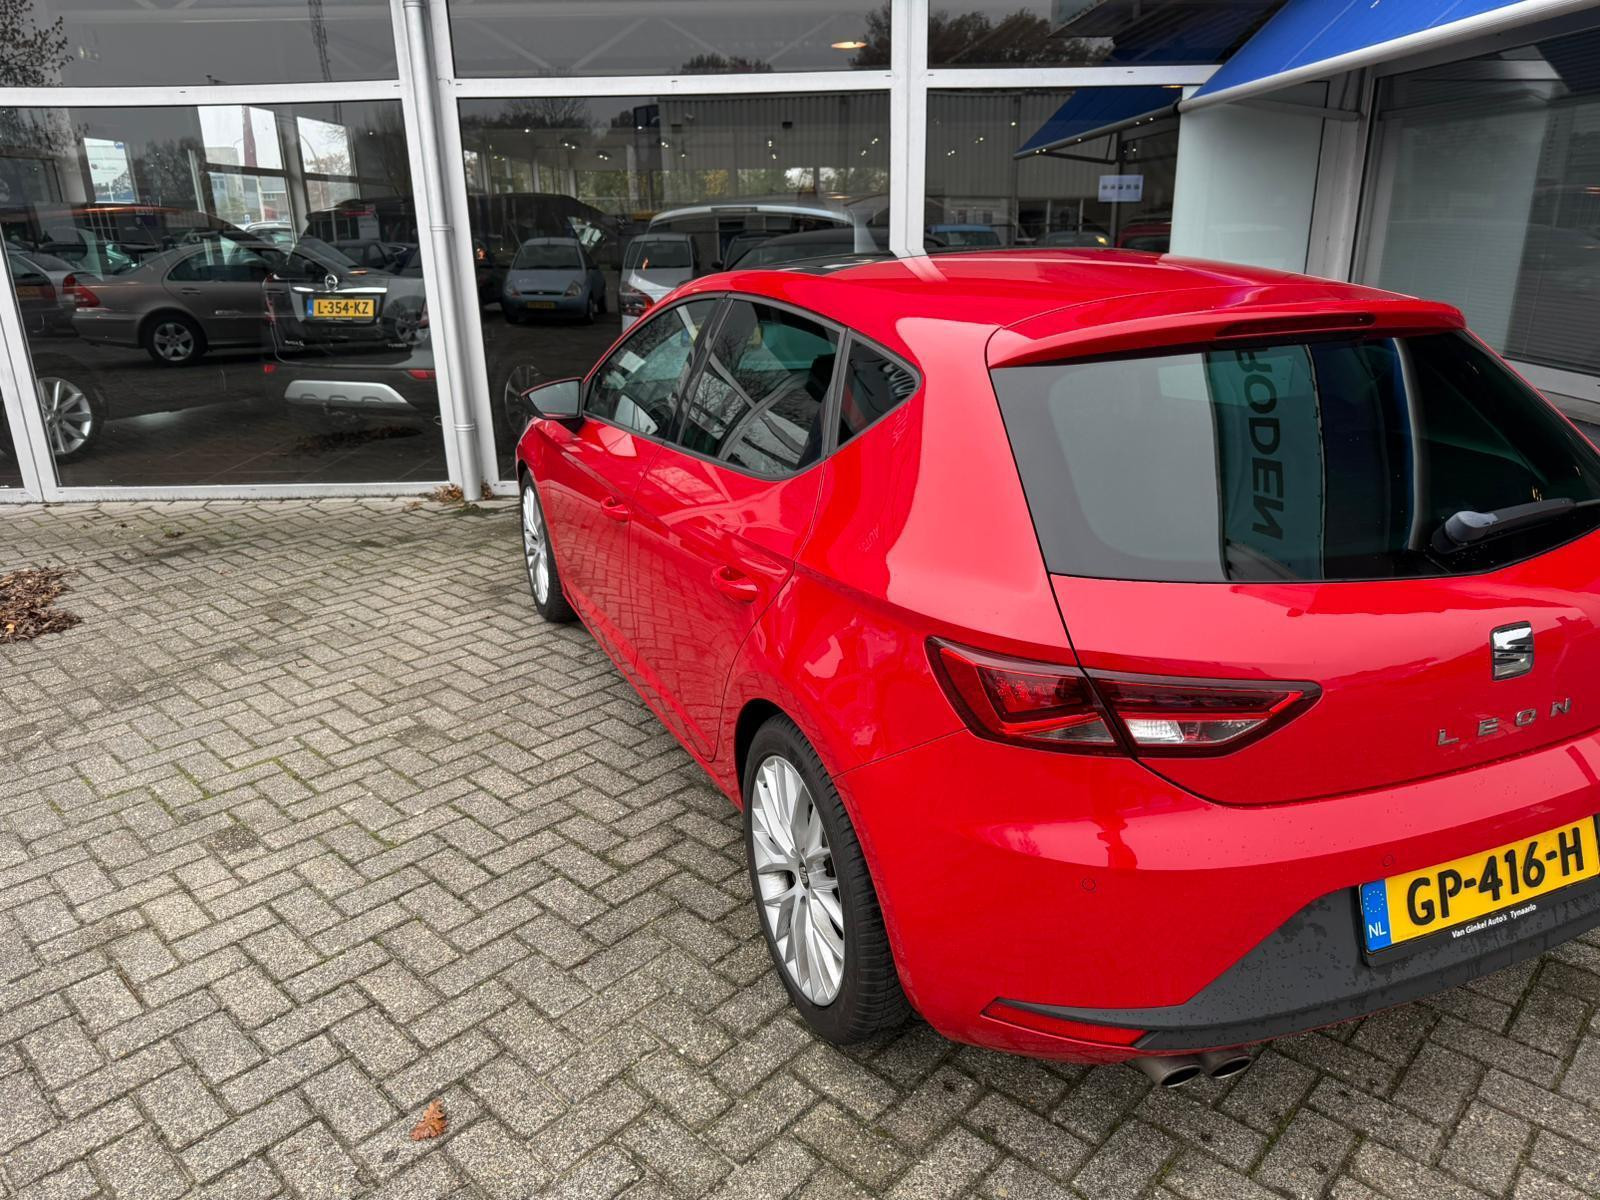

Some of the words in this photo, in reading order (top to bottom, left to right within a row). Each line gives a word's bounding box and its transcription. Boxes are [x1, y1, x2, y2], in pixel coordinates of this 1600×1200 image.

[317, 301, 369, 314] L-354-KZ
[1437, 697, 1571, 746] LEON
[1407, 827, 1584, 926] GP-416-H
[1369, 923, 1387, 938] NL
[1451, 930, 1465, 938] Van
[1465, 920, 1487, 934] Ginkel
[1487, 914, 1507, 926] Auto's
[1510, 904, 1537, 919] Tynaarlo
